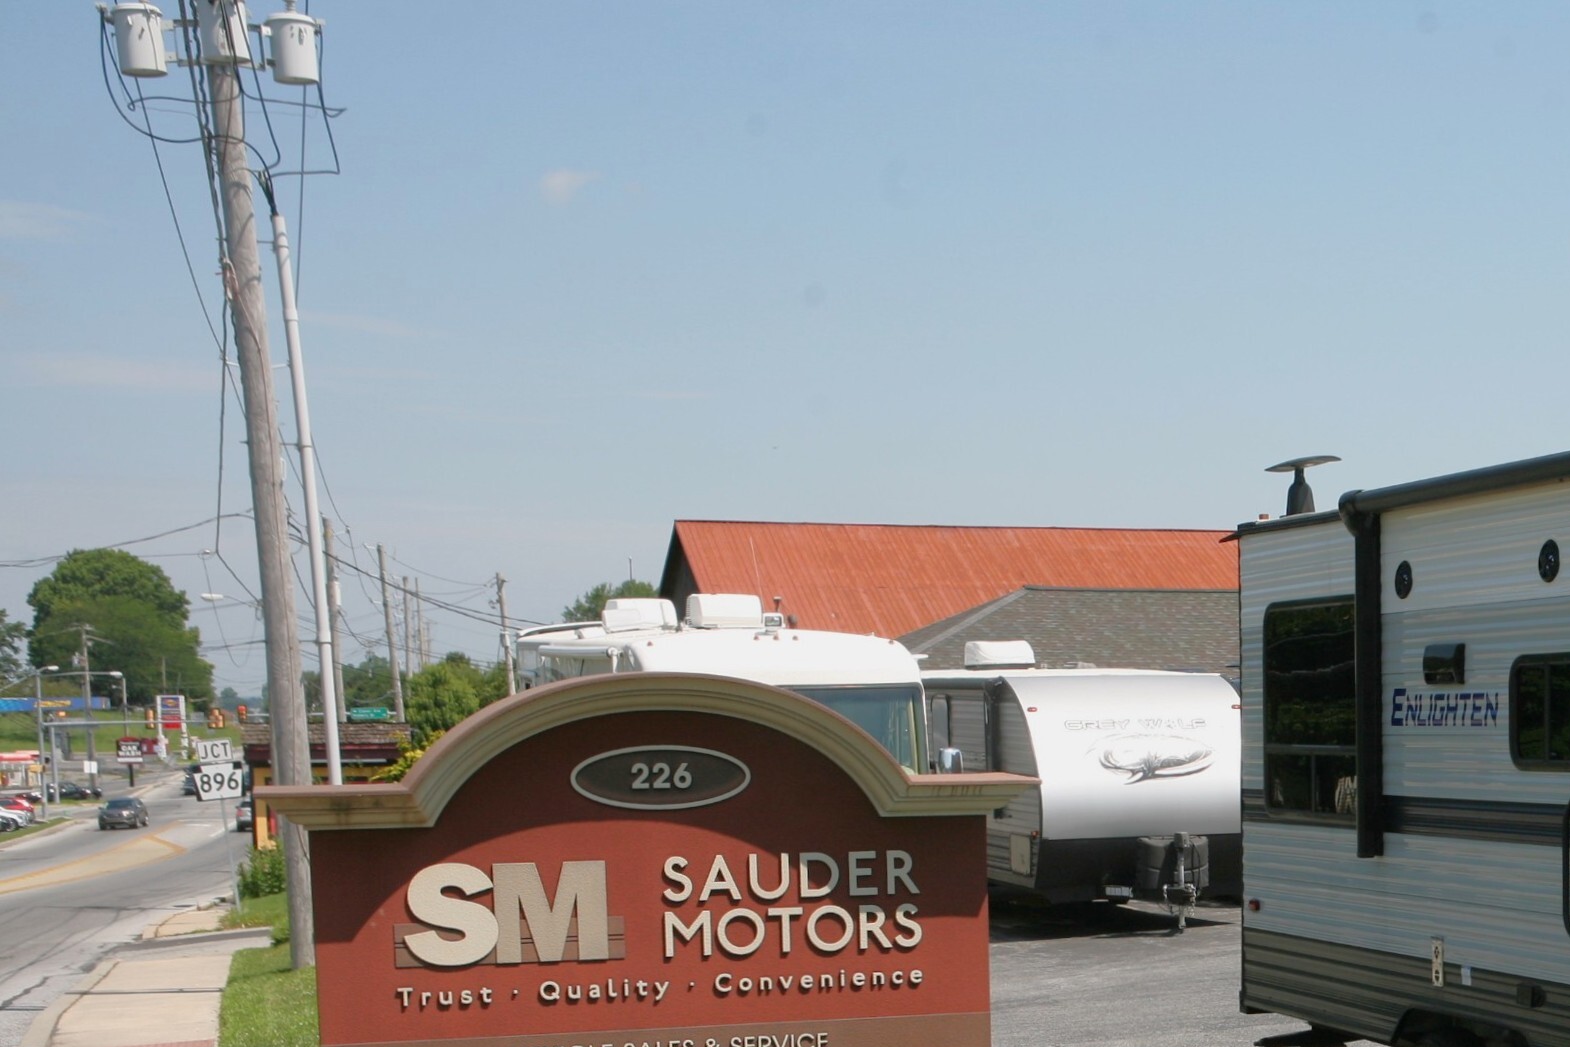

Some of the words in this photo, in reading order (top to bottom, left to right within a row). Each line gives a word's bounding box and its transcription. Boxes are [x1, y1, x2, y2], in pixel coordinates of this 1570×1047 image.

[1064, 718, 1131, 731] GREY
[1391, 688, 1498, 728] ENLIGHTEN
[201, 742, 228, 759] JCT
[200, 771, 239, 793] 896
[630, 762, 693, 791] 226
[662, 849, 921, 902] SAUDER
[402, 859, 609, 967] SM
[663, 903, 924, 959] MOTORS
[397, 986, 493, 1008] Trust
[539, 976, 671, 1002] Quality
[714, 967, 924, 994] Convenience
